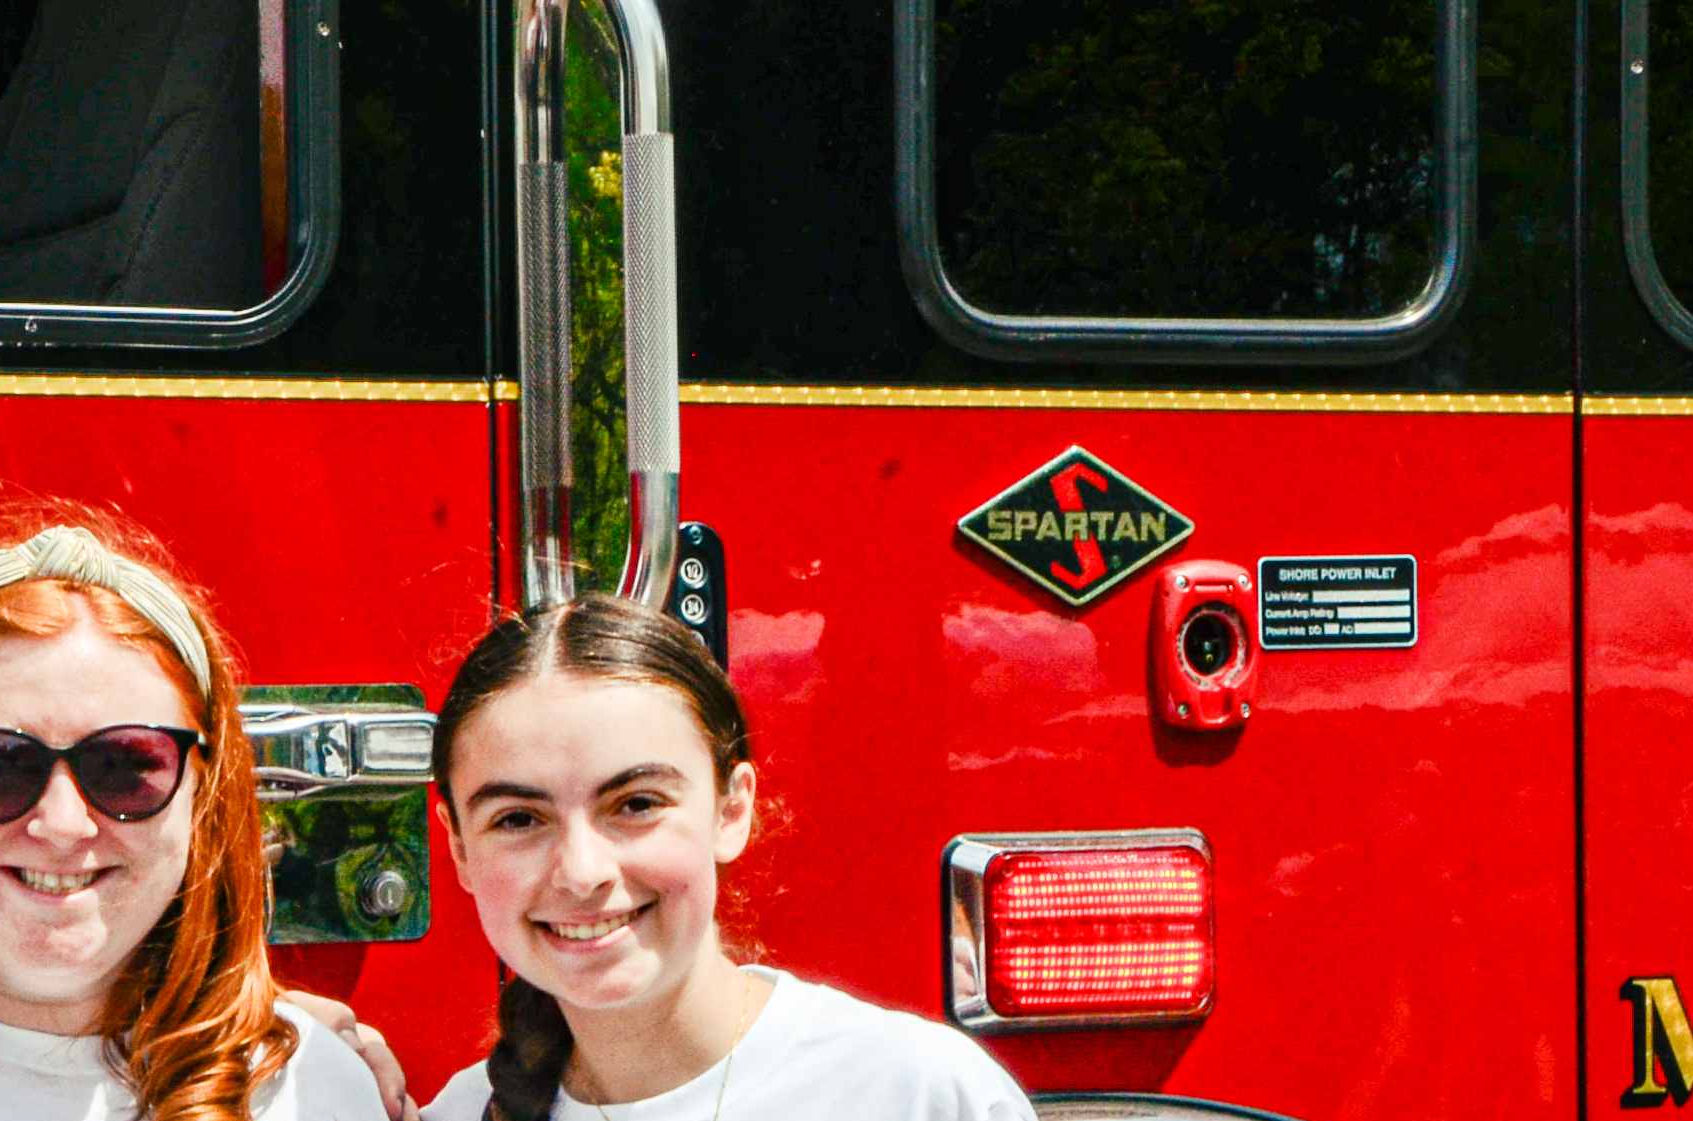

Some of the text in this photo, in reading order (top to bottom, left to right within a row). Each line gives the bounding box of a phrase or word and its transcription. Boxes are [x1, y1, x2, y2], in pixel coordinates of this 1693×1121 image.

[987, 510, 1167, 542] SPARTAN
[1278, 566, 1397, 581] SHORE POWER INLET
